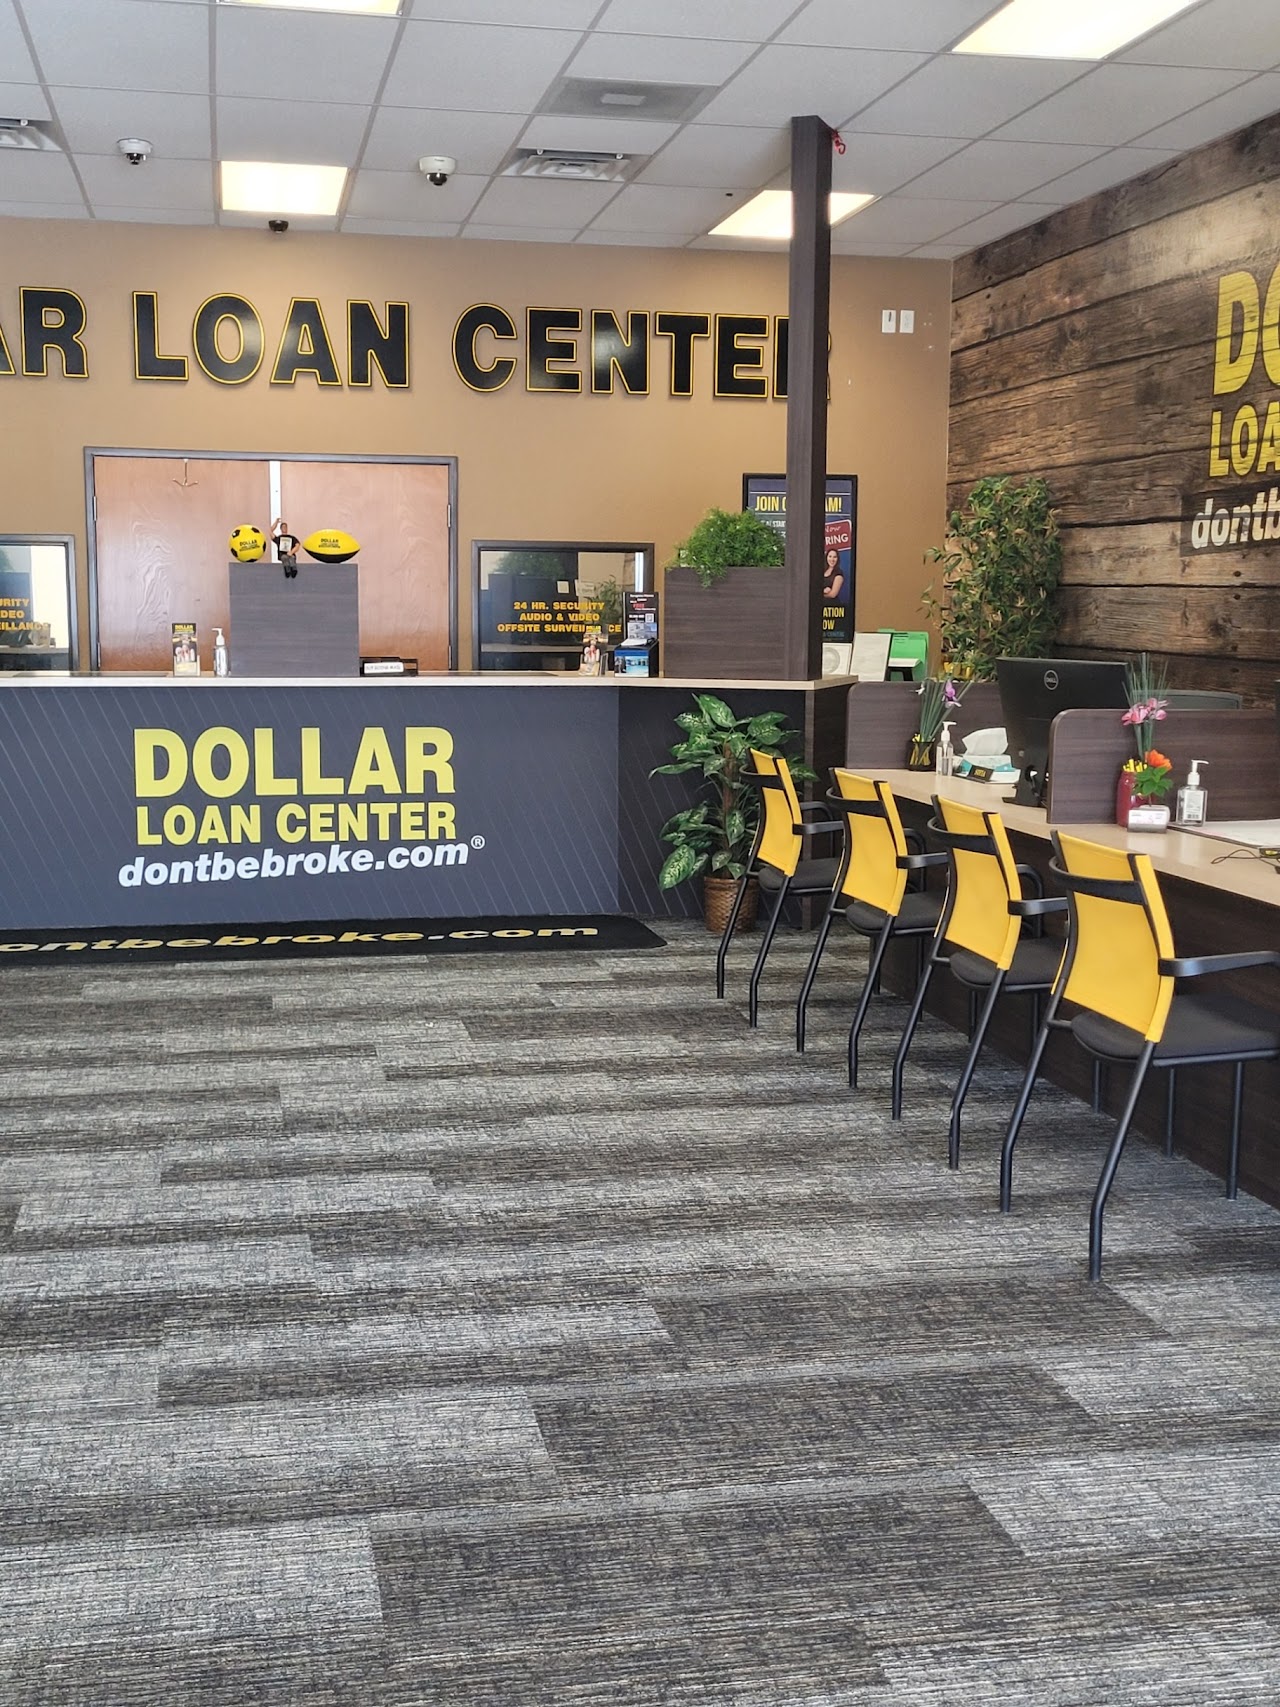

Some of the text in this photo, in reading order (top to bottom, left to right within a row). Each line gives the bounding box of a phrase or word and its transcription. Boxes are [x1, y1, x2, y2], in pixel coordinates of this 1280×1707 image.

[0, 285, 89, 378] R
[132, 291, 410, 388] LOAN
[754, 496, 779, 511] JOIN
[513, 602, 605, 610] 24 HR. SECURITY
[519, 613, 600, 621] AUDIO & VIDEO
[497, 624, 540, 632] OFFSITE
[133, 726, 456, 797] DOLLAR
[136, 802, 457, 846] LOAN CENTER
